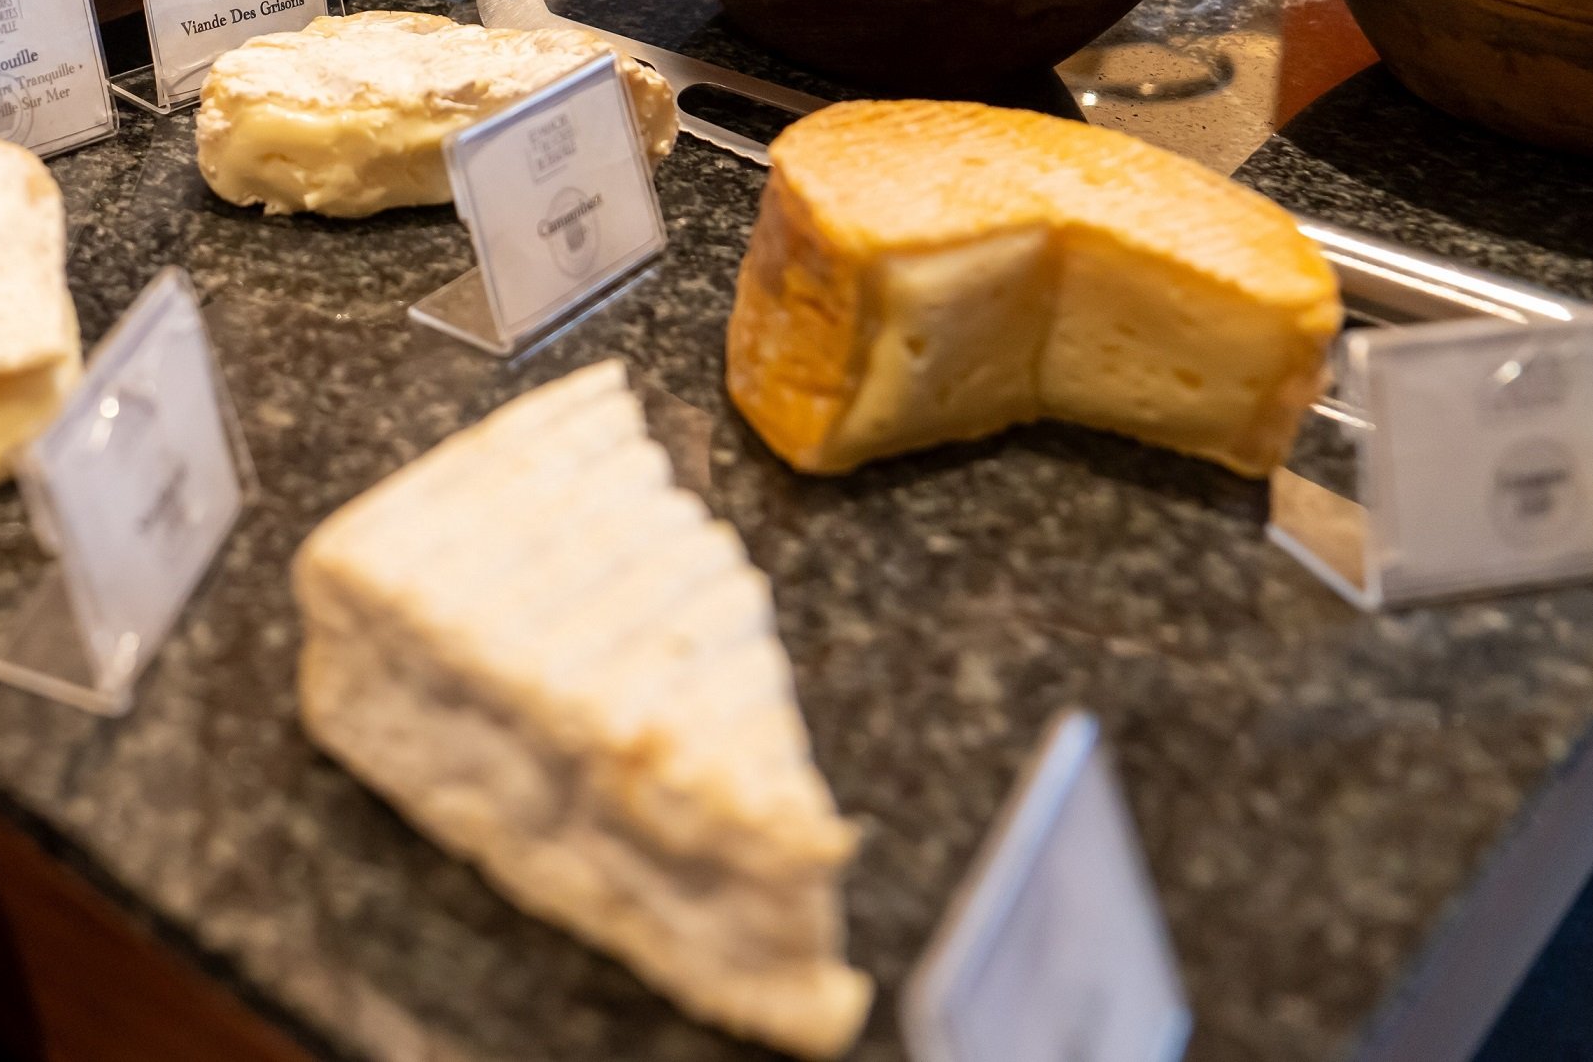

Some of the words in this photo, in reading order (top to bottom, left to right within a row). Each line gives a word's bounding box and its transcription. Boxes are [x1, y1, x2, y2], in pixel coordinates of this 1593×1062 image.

[180, 13, 227, 37] Viande
[229, 8, 257, 24] Des
[13, 62, 76, 90] Tranquille
[21, 96, 42, 111] Sur
[45, 87, 71, 104] Mer
